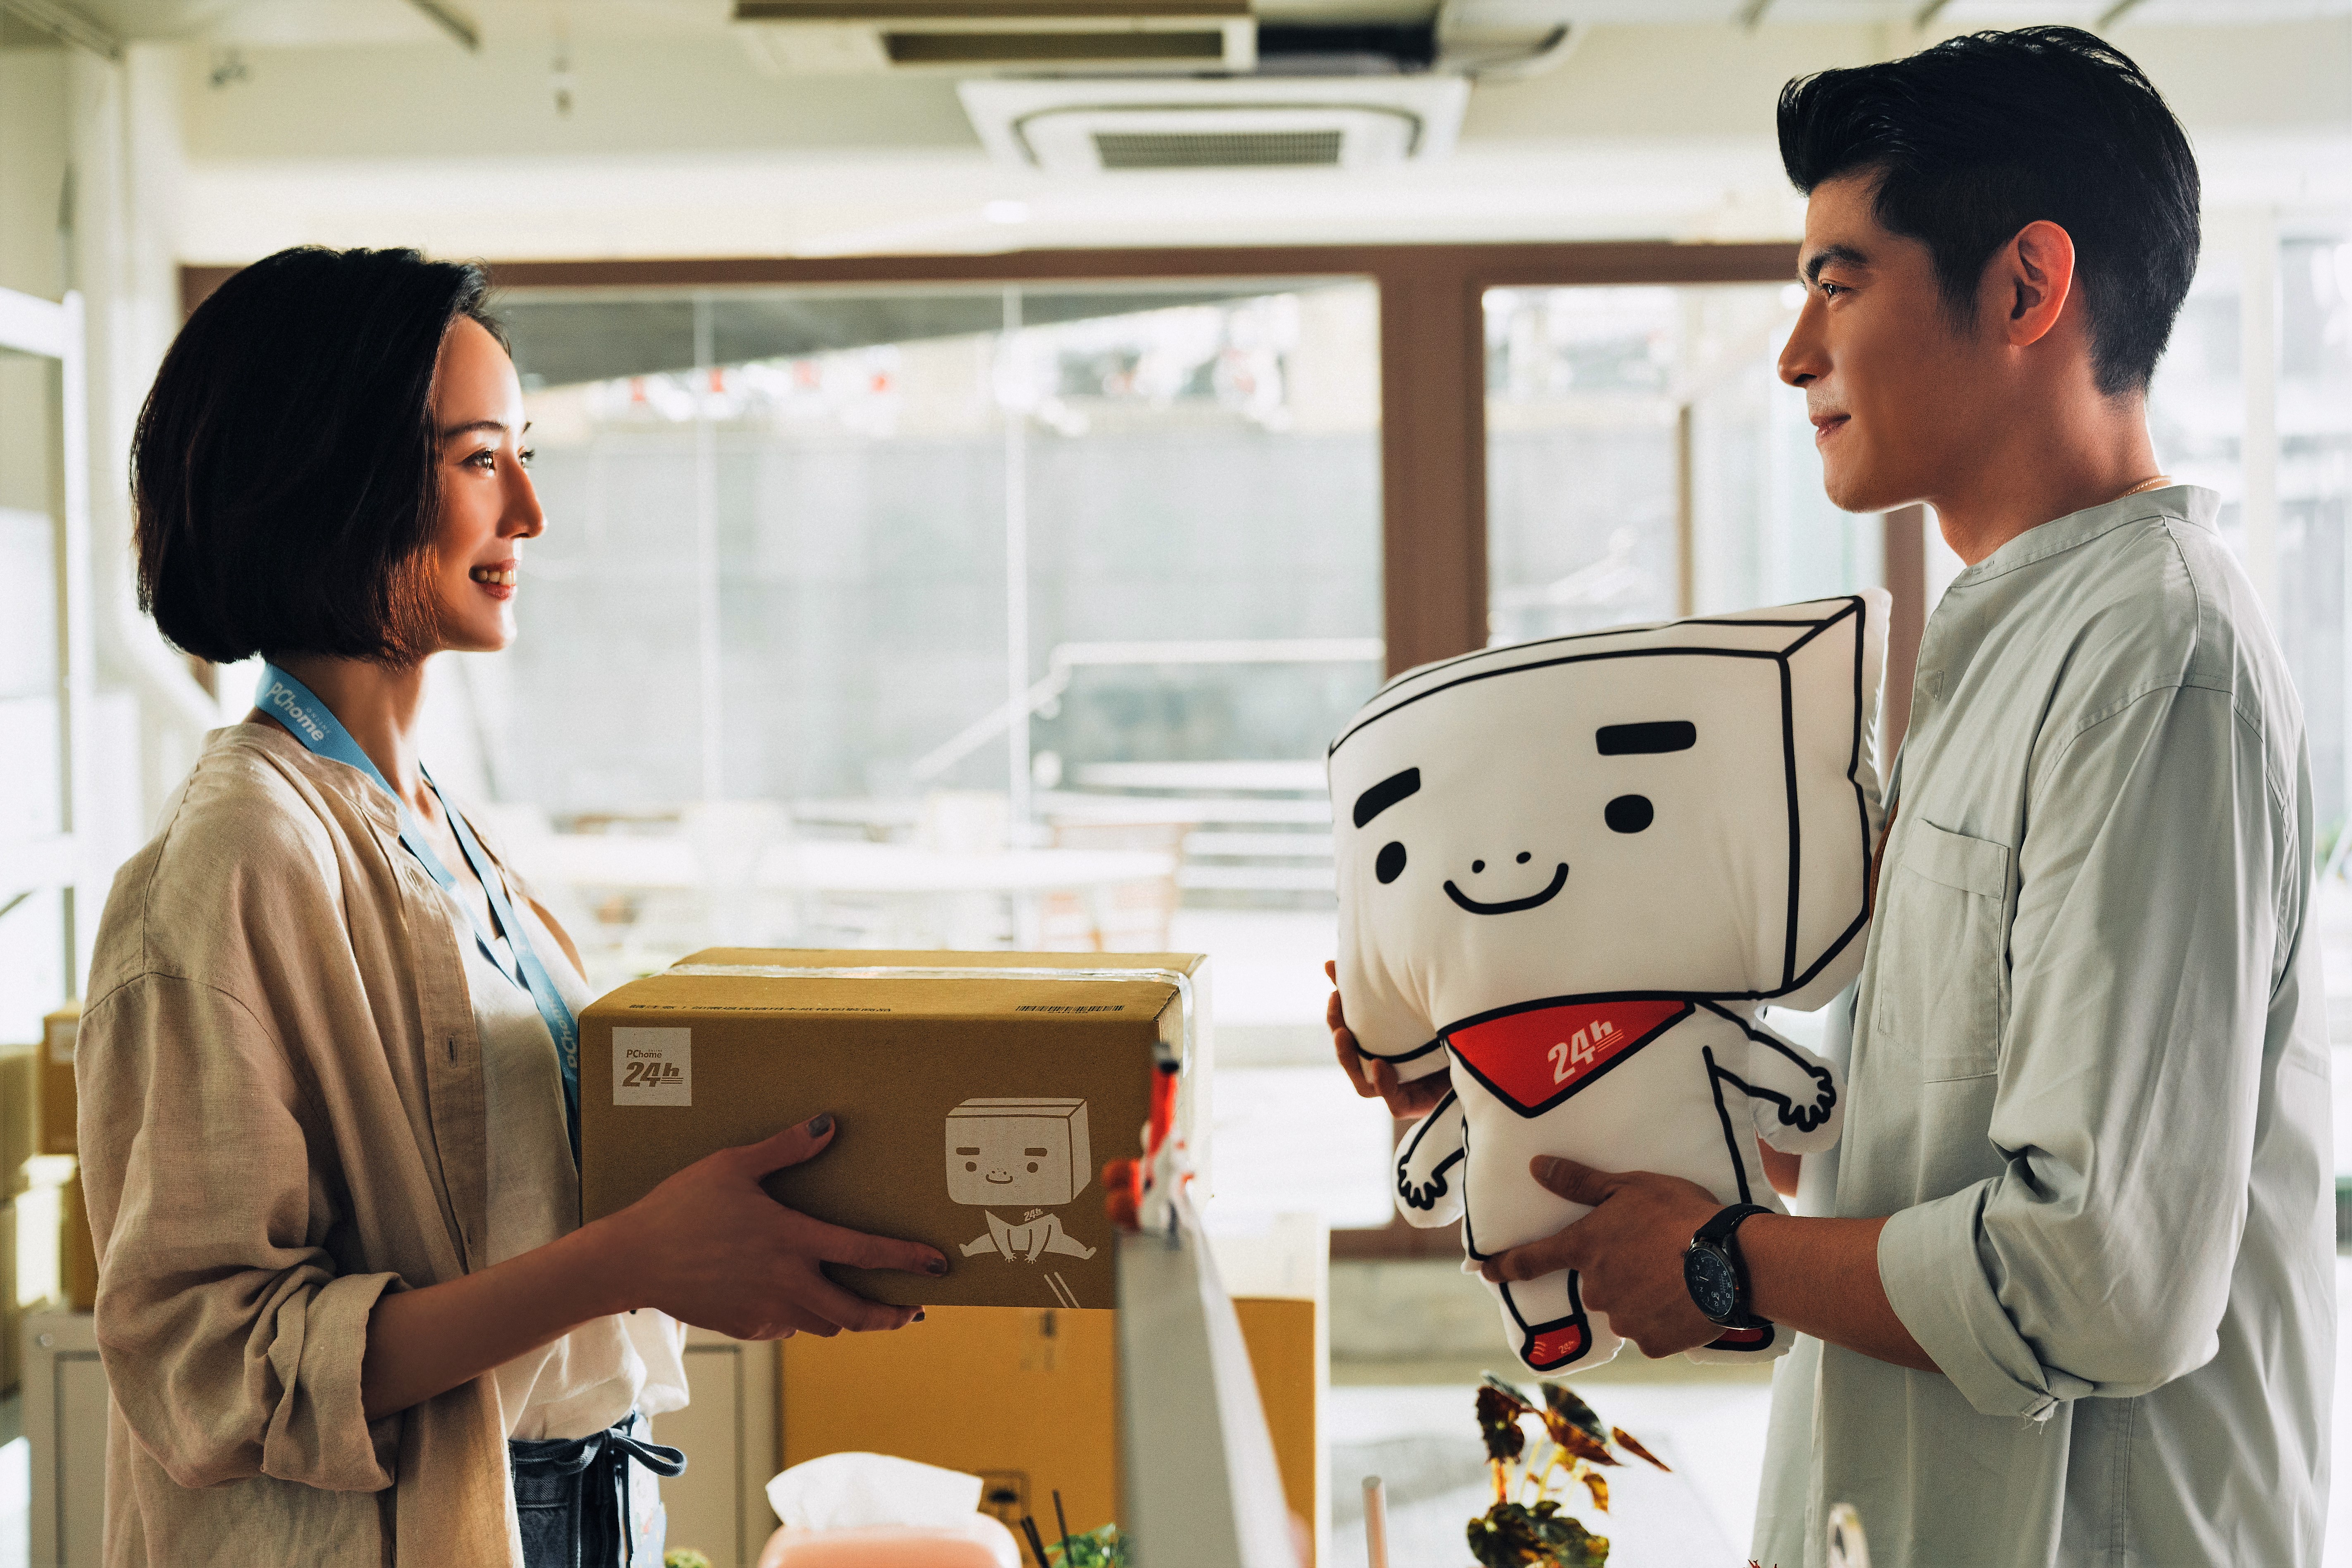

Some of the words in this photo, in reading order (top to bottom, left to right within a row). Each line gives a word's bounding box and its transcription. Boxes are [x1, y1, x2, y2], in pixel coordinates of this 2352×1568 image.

[265, 682, 324, 741] PChome
[626, 1049, 662, 1058] PChome
[1547, 1019, 1613, 1085] 24h
[622, 1062, 679, 1087] 24h
[1024, 1208, 1041, 1222] 24h
